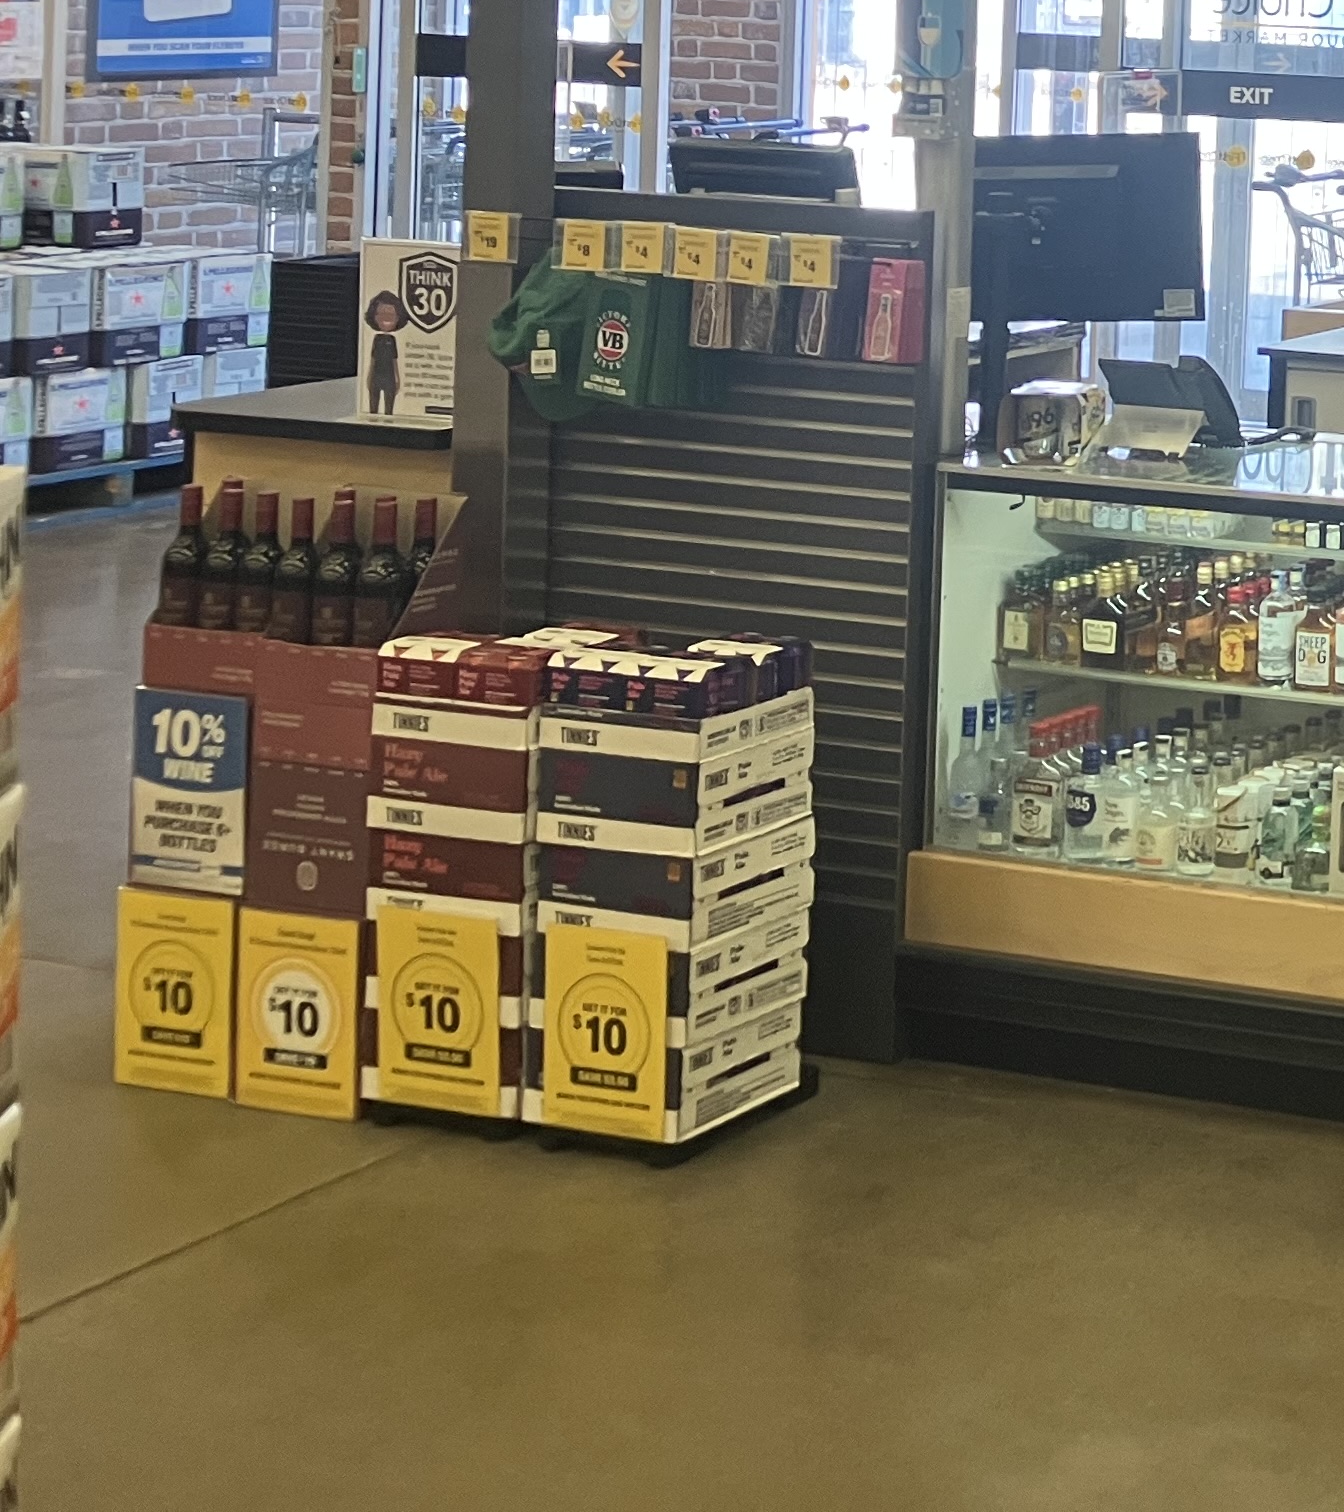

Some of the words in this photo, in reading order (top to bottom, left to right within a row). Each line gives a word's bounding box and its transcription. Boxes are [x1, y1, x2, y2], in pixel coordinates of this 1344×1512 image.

[1230, 86, 1273, 104] EXIT
[409, 270, 451, 287] THINK
[413, 287, 447, 317] 30
[602, 330, 624, 349] VB
[1299, 635, 1326, 649] SHEEP
[164, 758, 214, 783] WINE
[143, 976, 193, 1016] $10
[406, 993, 460, 1033] $10
[572, 1013, 627, 1056] $10
